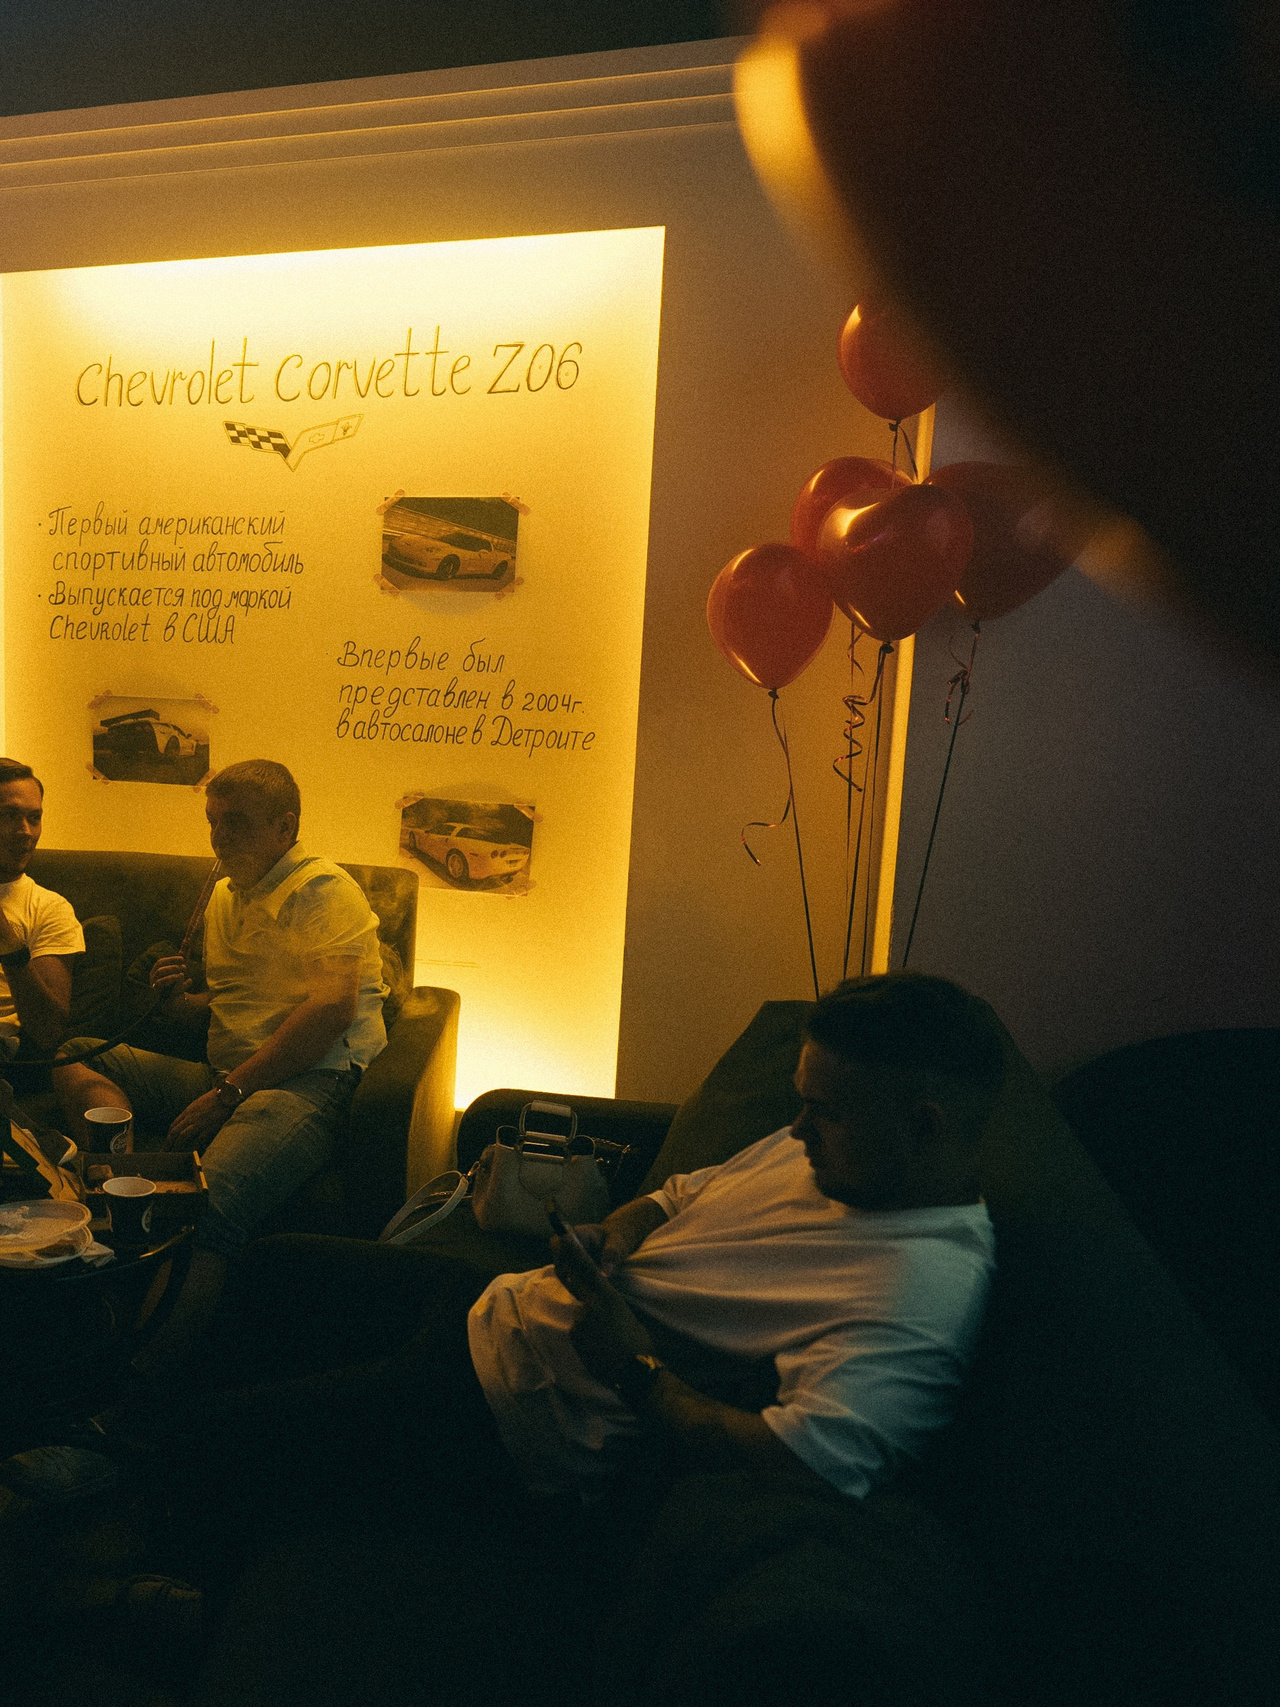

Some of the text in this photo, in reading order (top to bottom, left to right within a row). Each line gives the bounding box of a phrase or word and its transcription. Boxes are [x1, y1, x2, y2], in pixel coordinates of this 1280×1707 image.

[75, 325, 584, 407] Chevrolet Corvette Z06
[48, 500, 285, 546] Первый американский
[52, 538, 304, 580] спортивный автомобиль
[48, 580, 292, 620] Выпускается под маркой
[182, 612, 236, 644] США
[336, 635, 505, 676] Впервые был
[338, 676, 490, 718] представлен
[353, 708, 468, 744] автосалоне
[490, 714, 596, 758] Детроите
